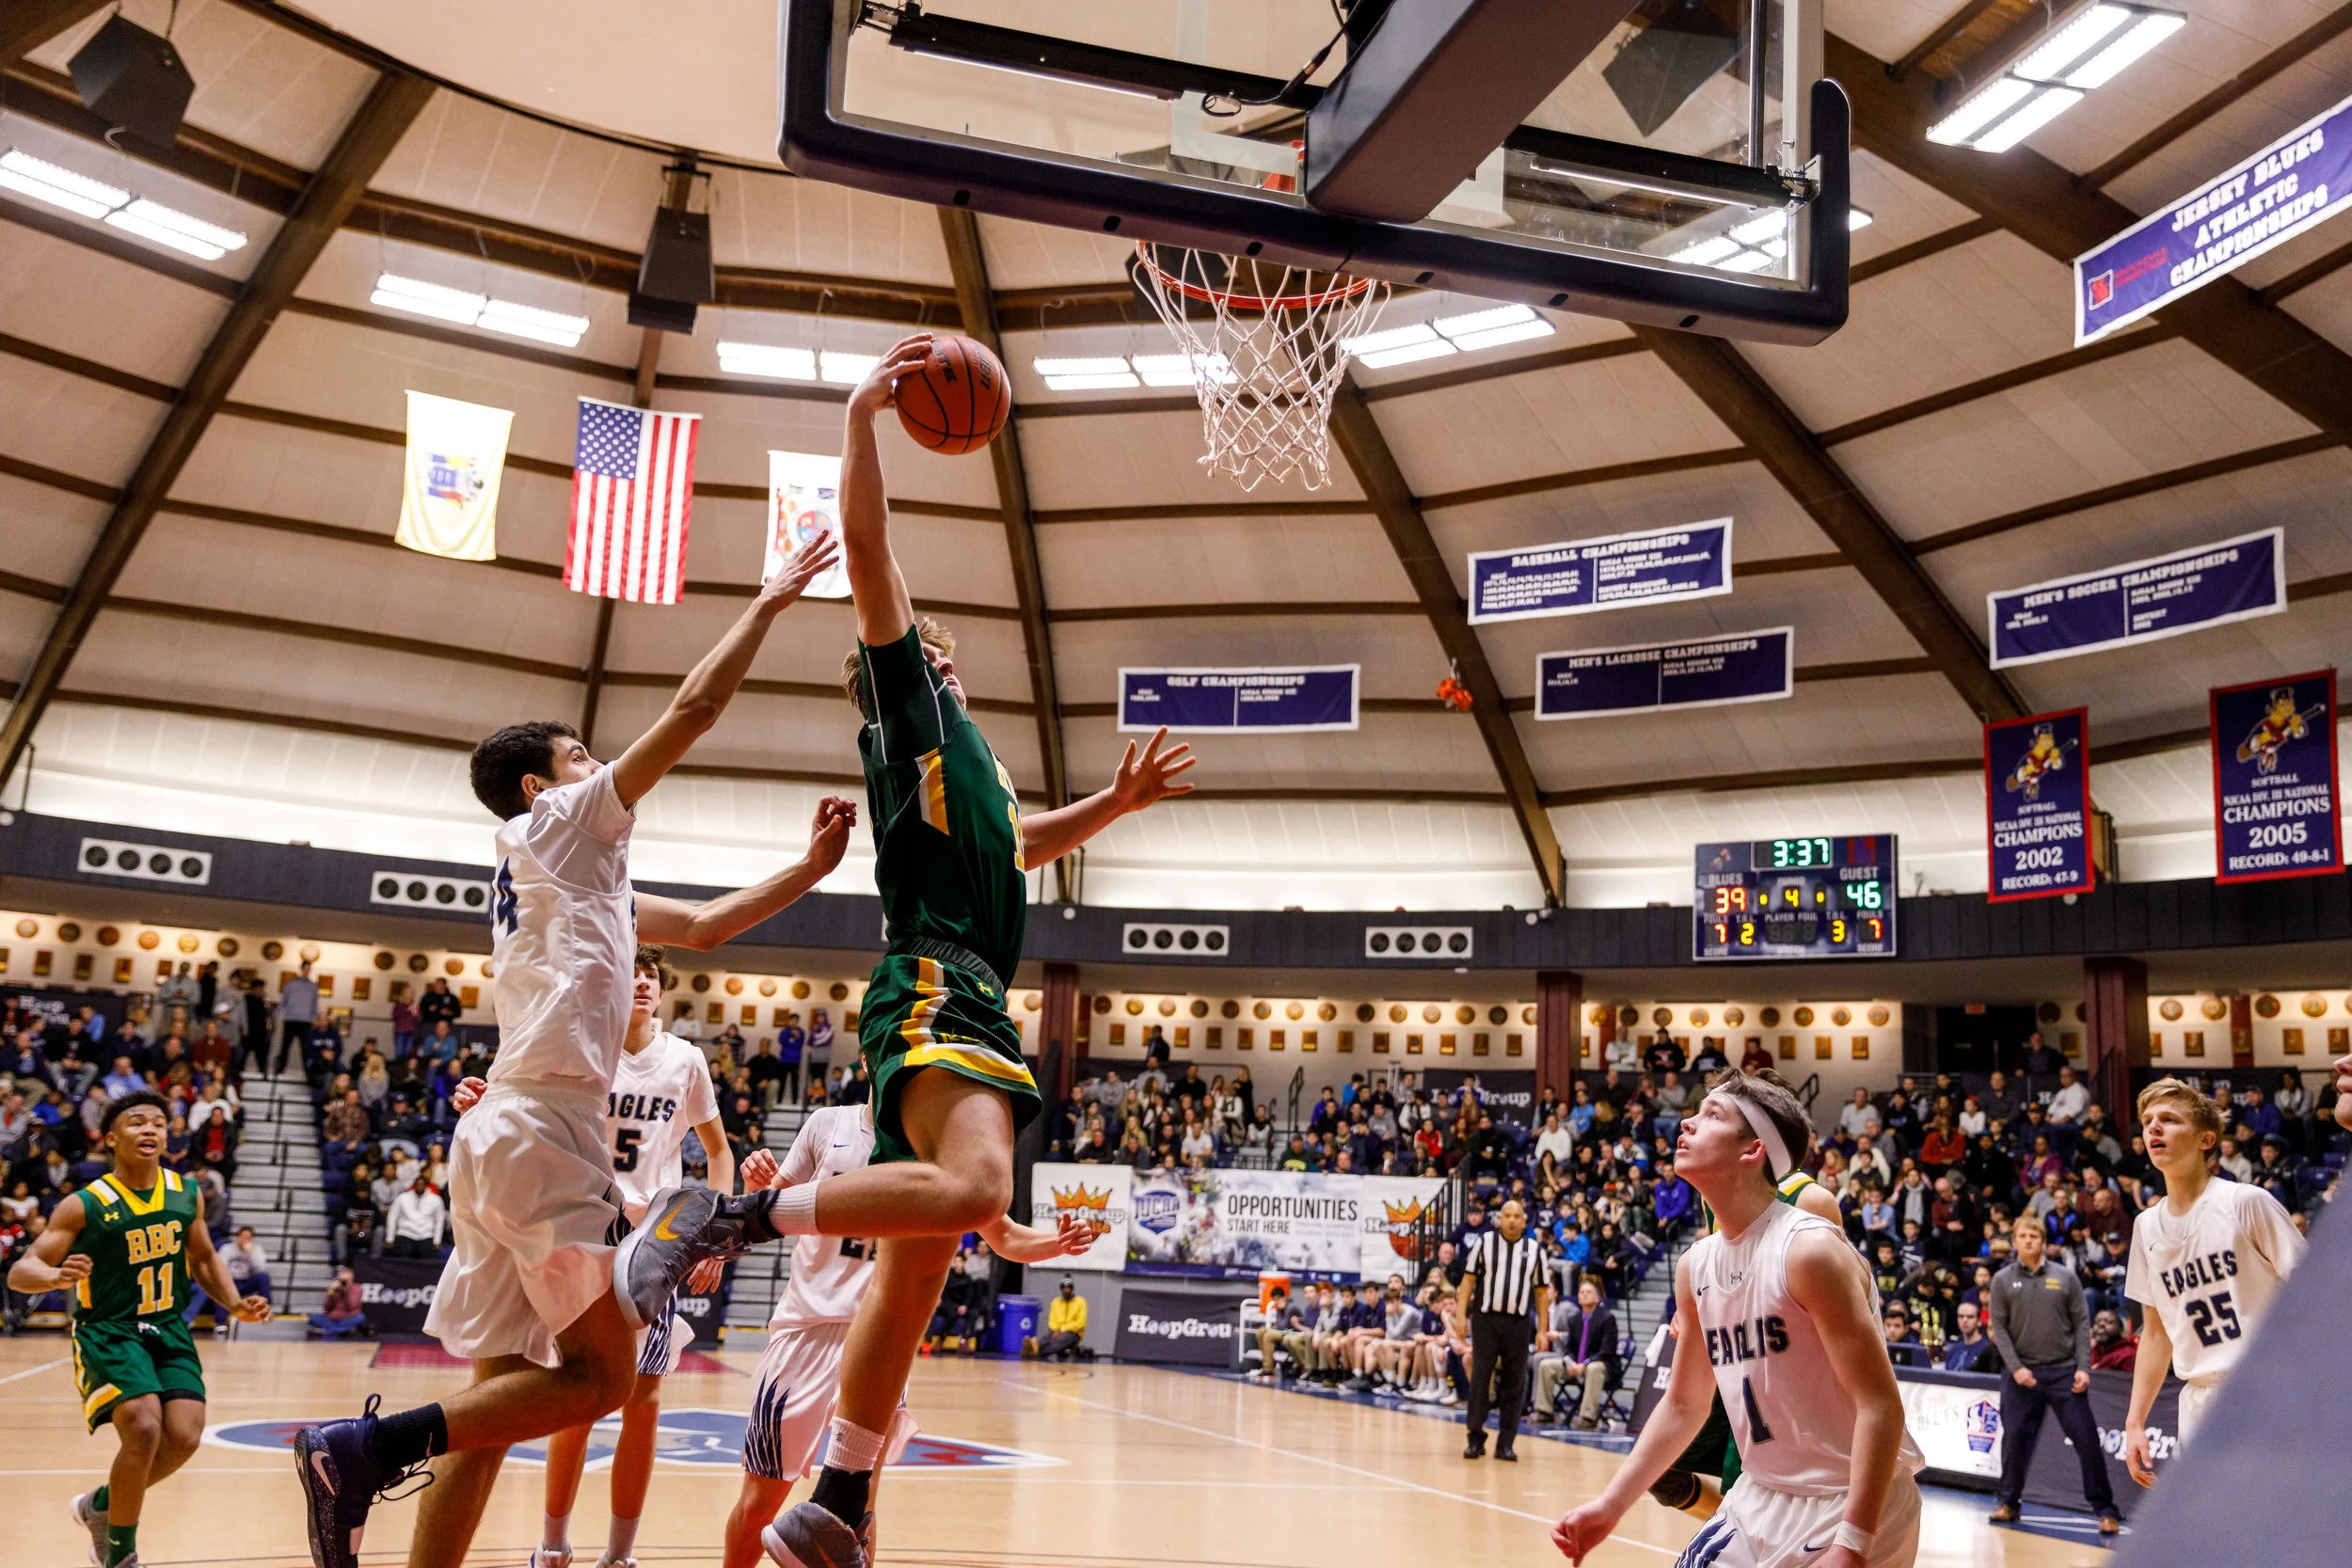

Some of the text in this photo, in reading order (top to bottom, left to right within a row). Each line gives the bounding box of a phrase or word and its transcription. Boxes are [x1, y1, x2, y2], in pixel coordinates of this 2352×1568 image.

[2171, 128, 2324, 232] JERSEY BLUES
[2194, 173, 2298, 248] ATHLETIC
[2170, 183, 2328, 287] CHAMPIONSHIPS
[1512, 549, 1578, 567] BASEBALL
[1581, 533, 1690, 559] CHAMPIONSHIPS
[2024, 588, 2064, 610] MEN'S
[2068, 577, 2118, 600] SOCCER
[2122, 548, 2239, 588] CHAMPIONSHIPS
[1569, 640, 1757, 669] MEN'S LACROSSE CHAMPIONSHIPS
[1167, 675, 1305, 687] GOLF CHAMPIONSHIPS
[2250, 773, 2300, 788] SOFTBALL
[2017, 800, 2057, 816] SOFTBALL
[2223, 796, 2331, 824] CHAMPIONS
[1994, 821, 2084, 848] CHAMPIONS
[2249, 820, 2308, 849] 2005
[1773, 838, 1830, 868] 3:37
[2015, 846, 2064, 871] 2002
[2229, 851, 2290, 871] RECORD:
[1708, 873, 1743, 886] BLUES
[1839, 865, 1880, 881] GUEST
[2002, 872, 2053, 891] RECORD:
[1715, 885, 1747, 915] 39
[1785, 888, 1800, 908] 4
[1846, 880, 1883, 910] 46
[1714, 923, 1728, 944] 7
[1740, 922, 1755, 945] 2
[1833, 919, 1846, 942] 3
[1867, 917, 1883, 940] 7
[607, 1092, 676, 1123] AGLES
[612, 1128, 642, 1174] 5
[1228, 1195, 1358, 1221] OPPORTUNITIES
[1227, 1217, 1261, 1232] START
[1263, 1219, 1290, 1234] HERE
[125, 1219, 183, 1265] RBC
[2160, 1249, 2239, 1298] EAGLES
[136, 1261, 174, 1316] 11
[361, 1282, 437, 1308] HoopG
[1128, 1313, 1232, 1339] HoopGrou
[2185, 1291, 2242, 1349] 25
[1742, 1374, 1774, 1446] 1
